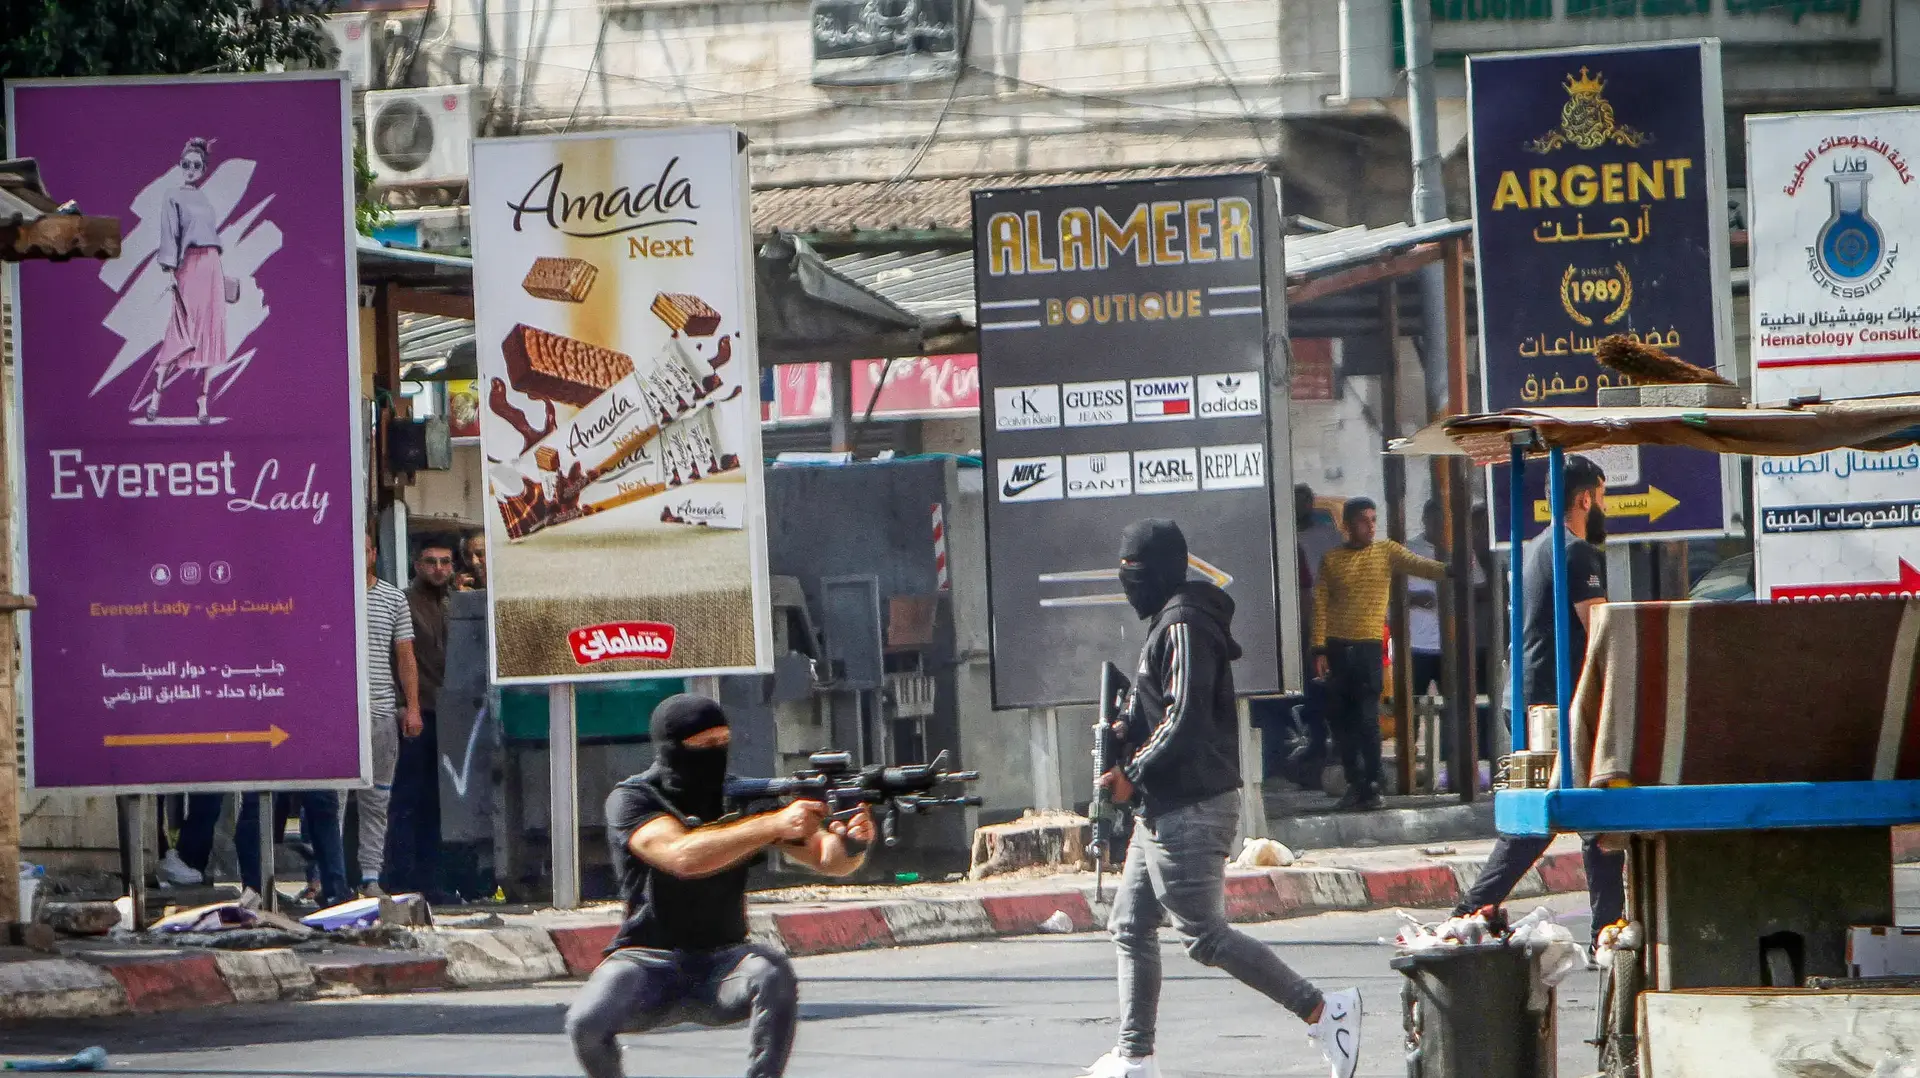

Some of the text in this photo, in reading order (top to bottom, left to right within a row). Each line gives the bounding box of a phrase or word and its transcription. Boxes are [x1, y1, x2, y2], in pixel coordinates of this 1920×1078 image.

[507, 156, 700, 232] Amada
[1491, 158, 1692, 211] ARGENT
[627, 235, 694, 259] Next
[987, 196, 1254, 276] ALAMEER
[1805, 242, 1899, 299] PROFESSIONAL
[1571, 278, 1621, 303] 1989
[1046, 289, 1203, 326] BOUTIQUE
[1760, 312, 1805, 331] الطبية
[1519, 330, 1599, 357] ساعات
[1760, 325, 1920, 347] Hematology Consult
[1134, 382, 1189, 396] TOMMY
[1520, 371, 1589, 401] مفرق
[1066, 389, 1123, 409] GUESS
[1201, 397, 1259, 413] adidas
[566, 392, 636, 457] Amada
[1079, 410, 1113, 422] JEANS
[1011, 462, 1046, 482] NIKE
[1139, 459, 1193, 478] KARL
[1204, 451, 1261, 479] REPLAY
[49, 449, 330, 525] Everest Lady
[1069, 478, 1128, 492] GANT
[1765, 509, 1821, 532] الطبية
[1823, 504, 1909, 528] الفحوصات
